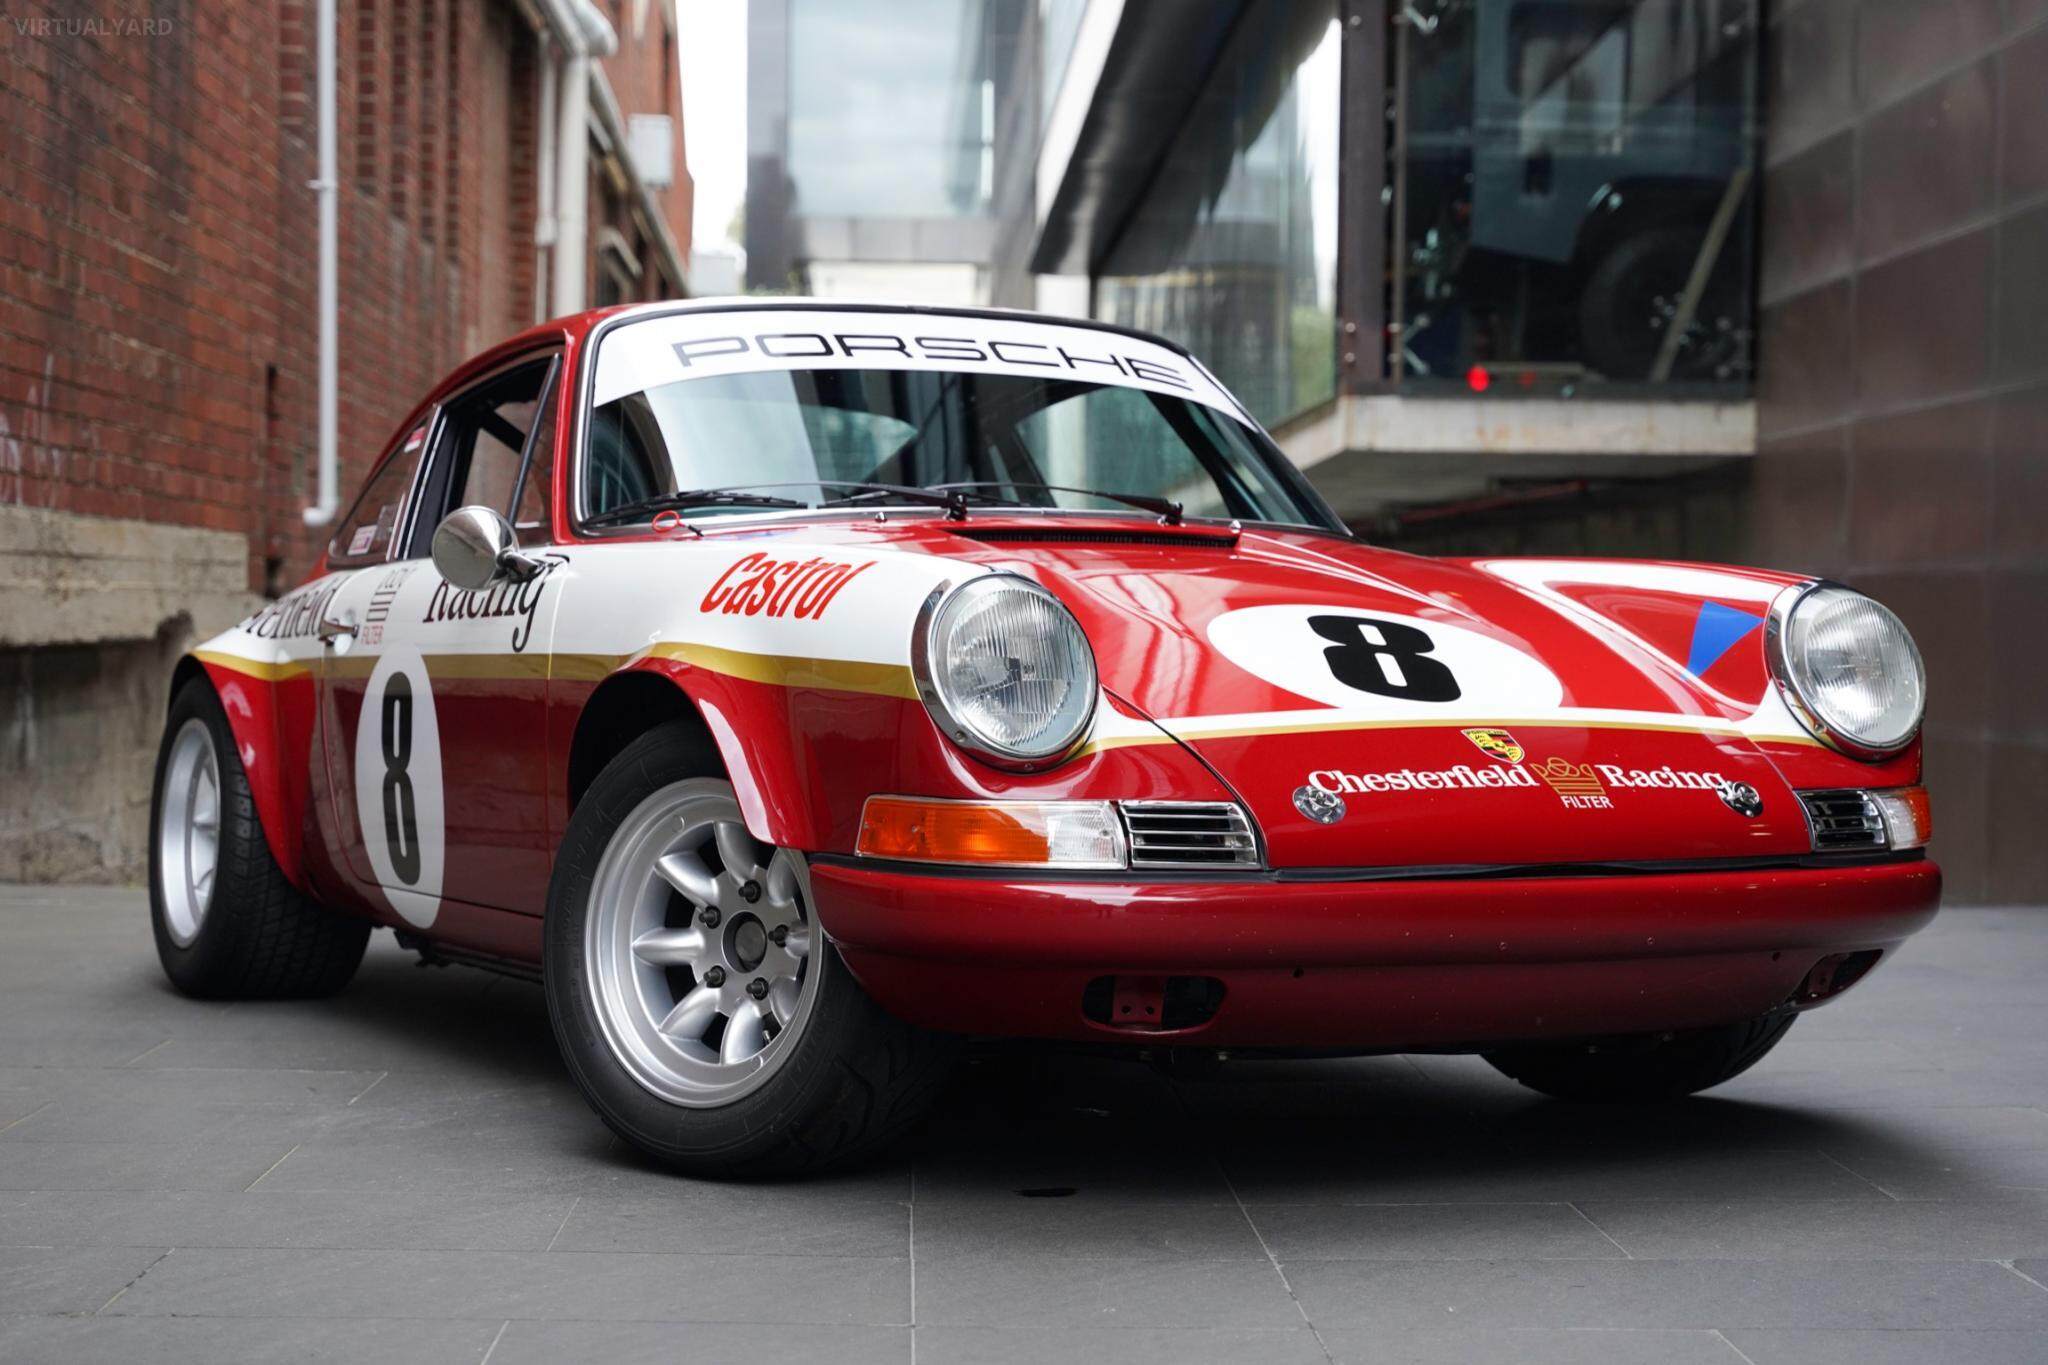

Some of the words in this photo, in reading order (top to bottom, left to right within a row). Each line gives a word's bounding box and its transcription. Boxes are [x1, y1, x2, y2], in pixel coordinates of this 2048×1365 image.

[672, 334, 1193, 391] PORSCHE
[700, 552, 879, 620] Castrol
[1307, 615, 1461, 701] 8
[382, 671, 421, 885] 8
[1308, 764, 1540, 794] Chesterfield
[1596, 764, 1734, 801] Racing
[1561, 795, 1614, 809] FILTER
